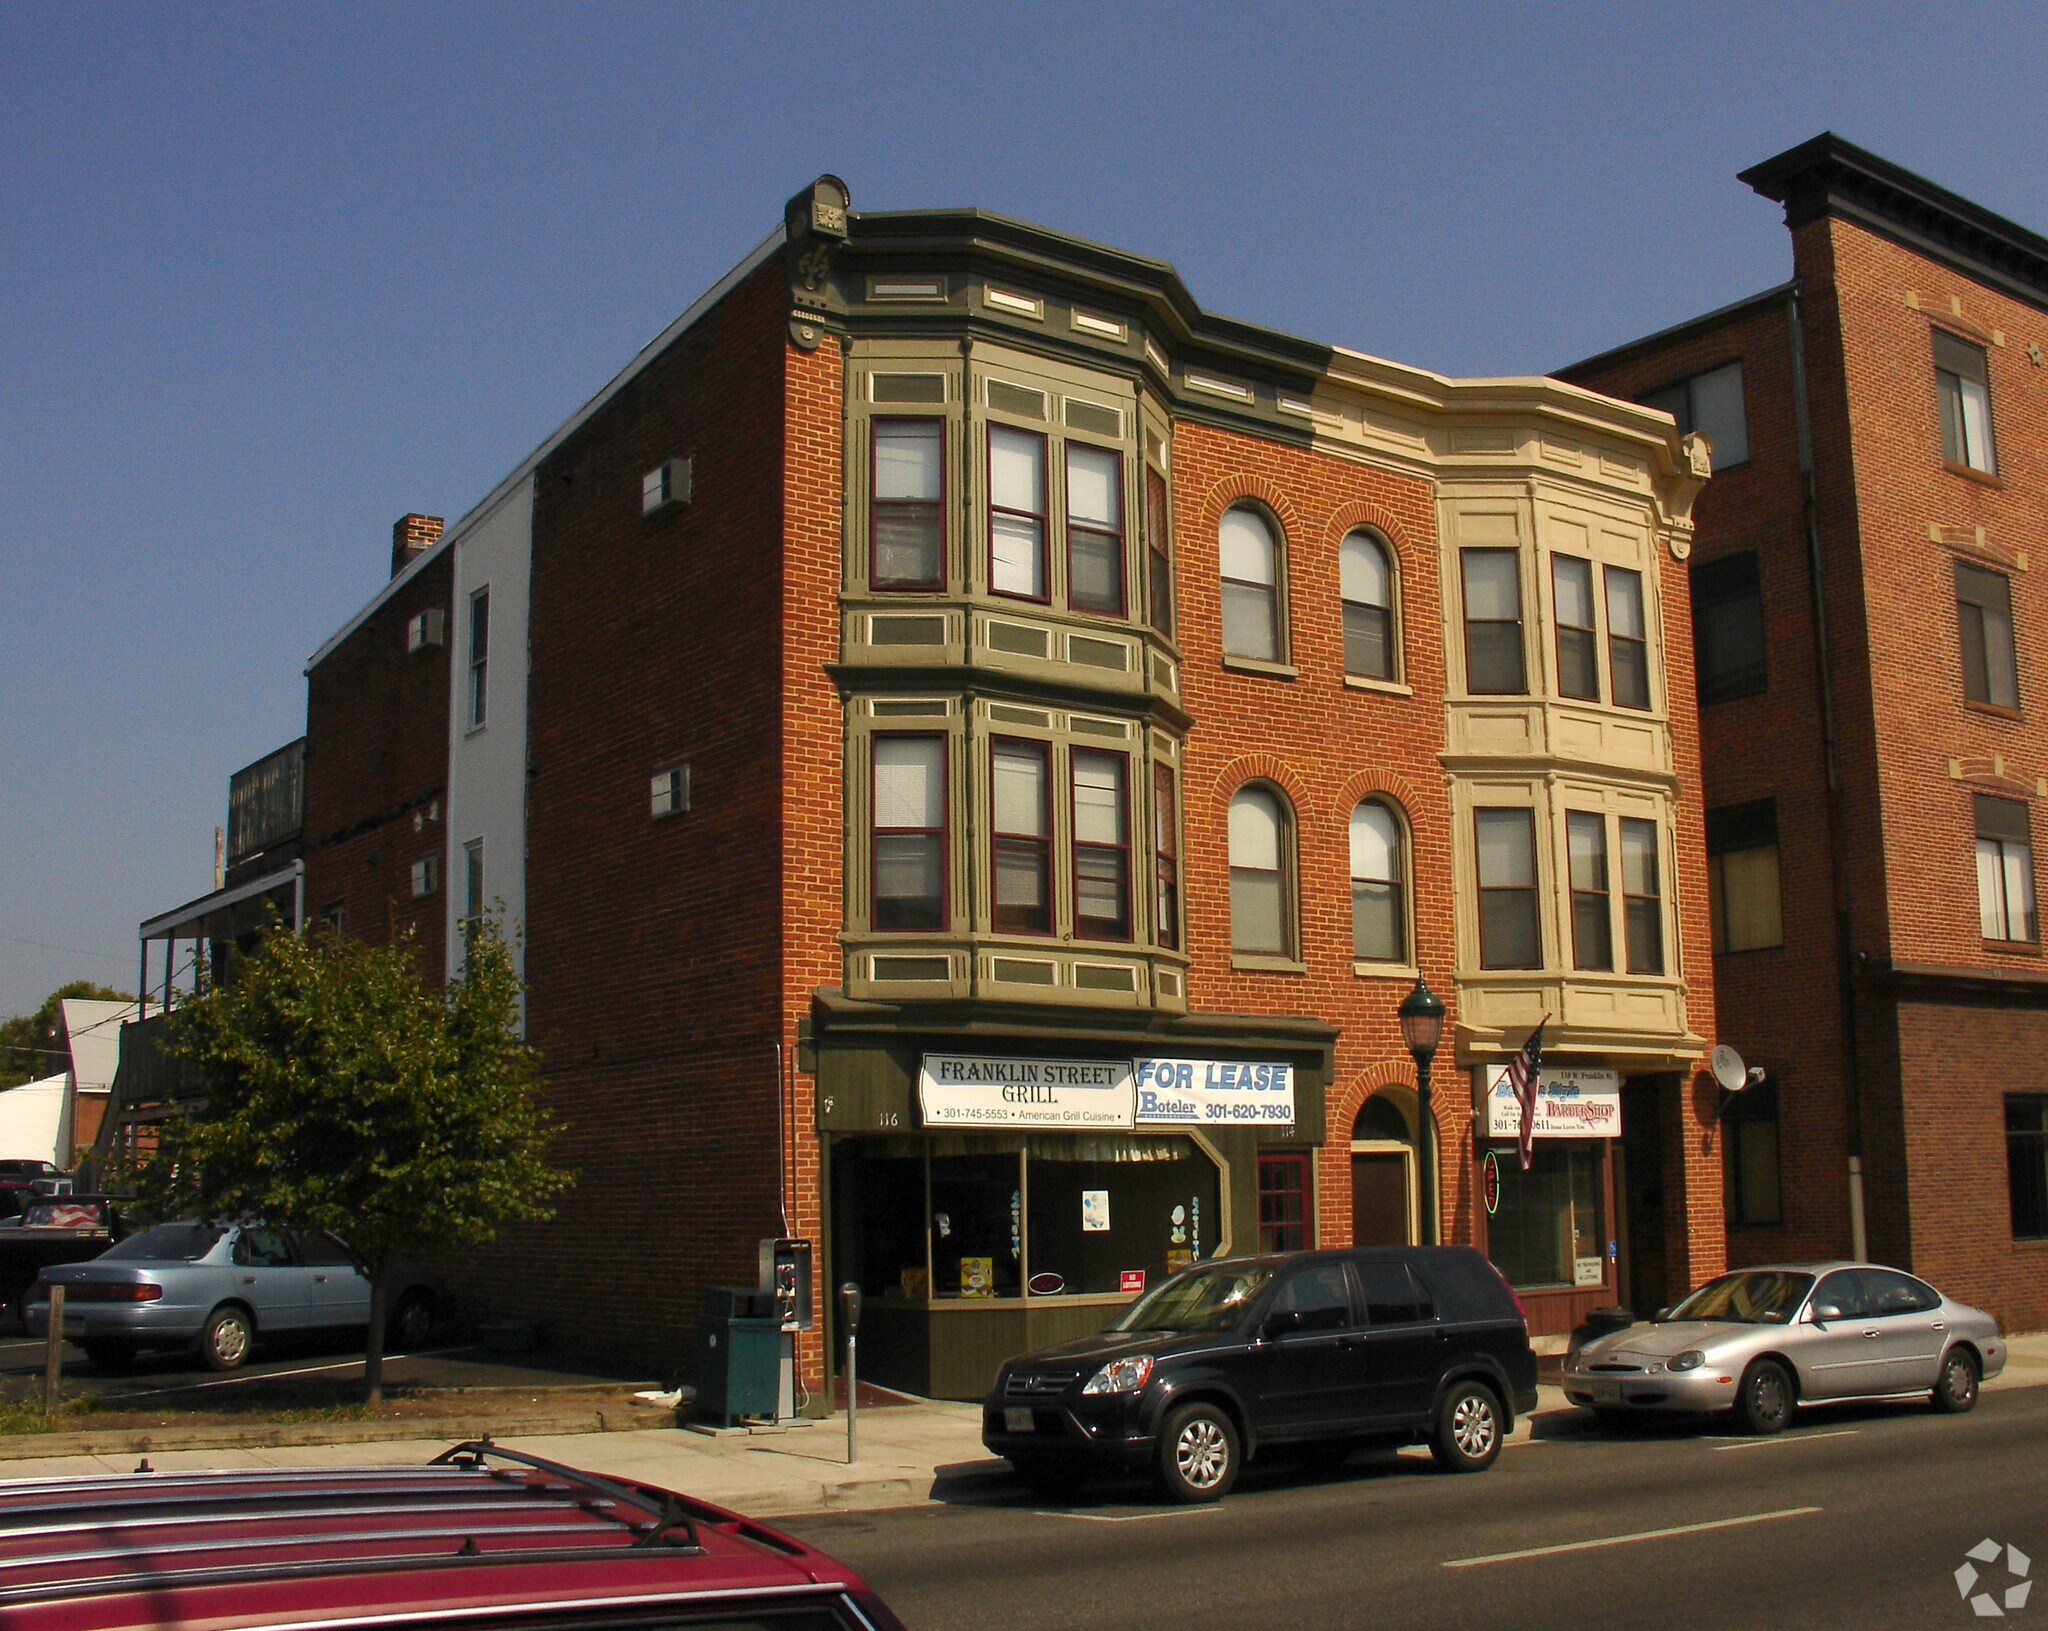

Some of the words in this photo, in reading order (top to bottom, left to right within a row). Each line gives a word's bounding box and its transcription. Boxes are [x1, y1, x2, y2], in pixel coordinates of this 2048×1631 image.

[940, 1061, 1038, 1083] FRANKLIN
[1044, 1065, 1116, 1085] STREET
[1137, 1061, 1193, 1089] FOR
[1205, 1064, 1288, 1091] LEASE
[1002, 1086, 1058, 1103] GRILL
[1140, 1091, 1197, 1113] Boteler
[943, 1107, 1008, 1119] 301-745-5553
[1018, 1109, 1061, 1121] American
[1063, 1111, 1081, 1121] Grill
[1082, 1112, 1115, 1122] Cuisine
[1205, 1103, 1291, 1119] 301-620-7930
[880, 1113, 899, 1127] 116
